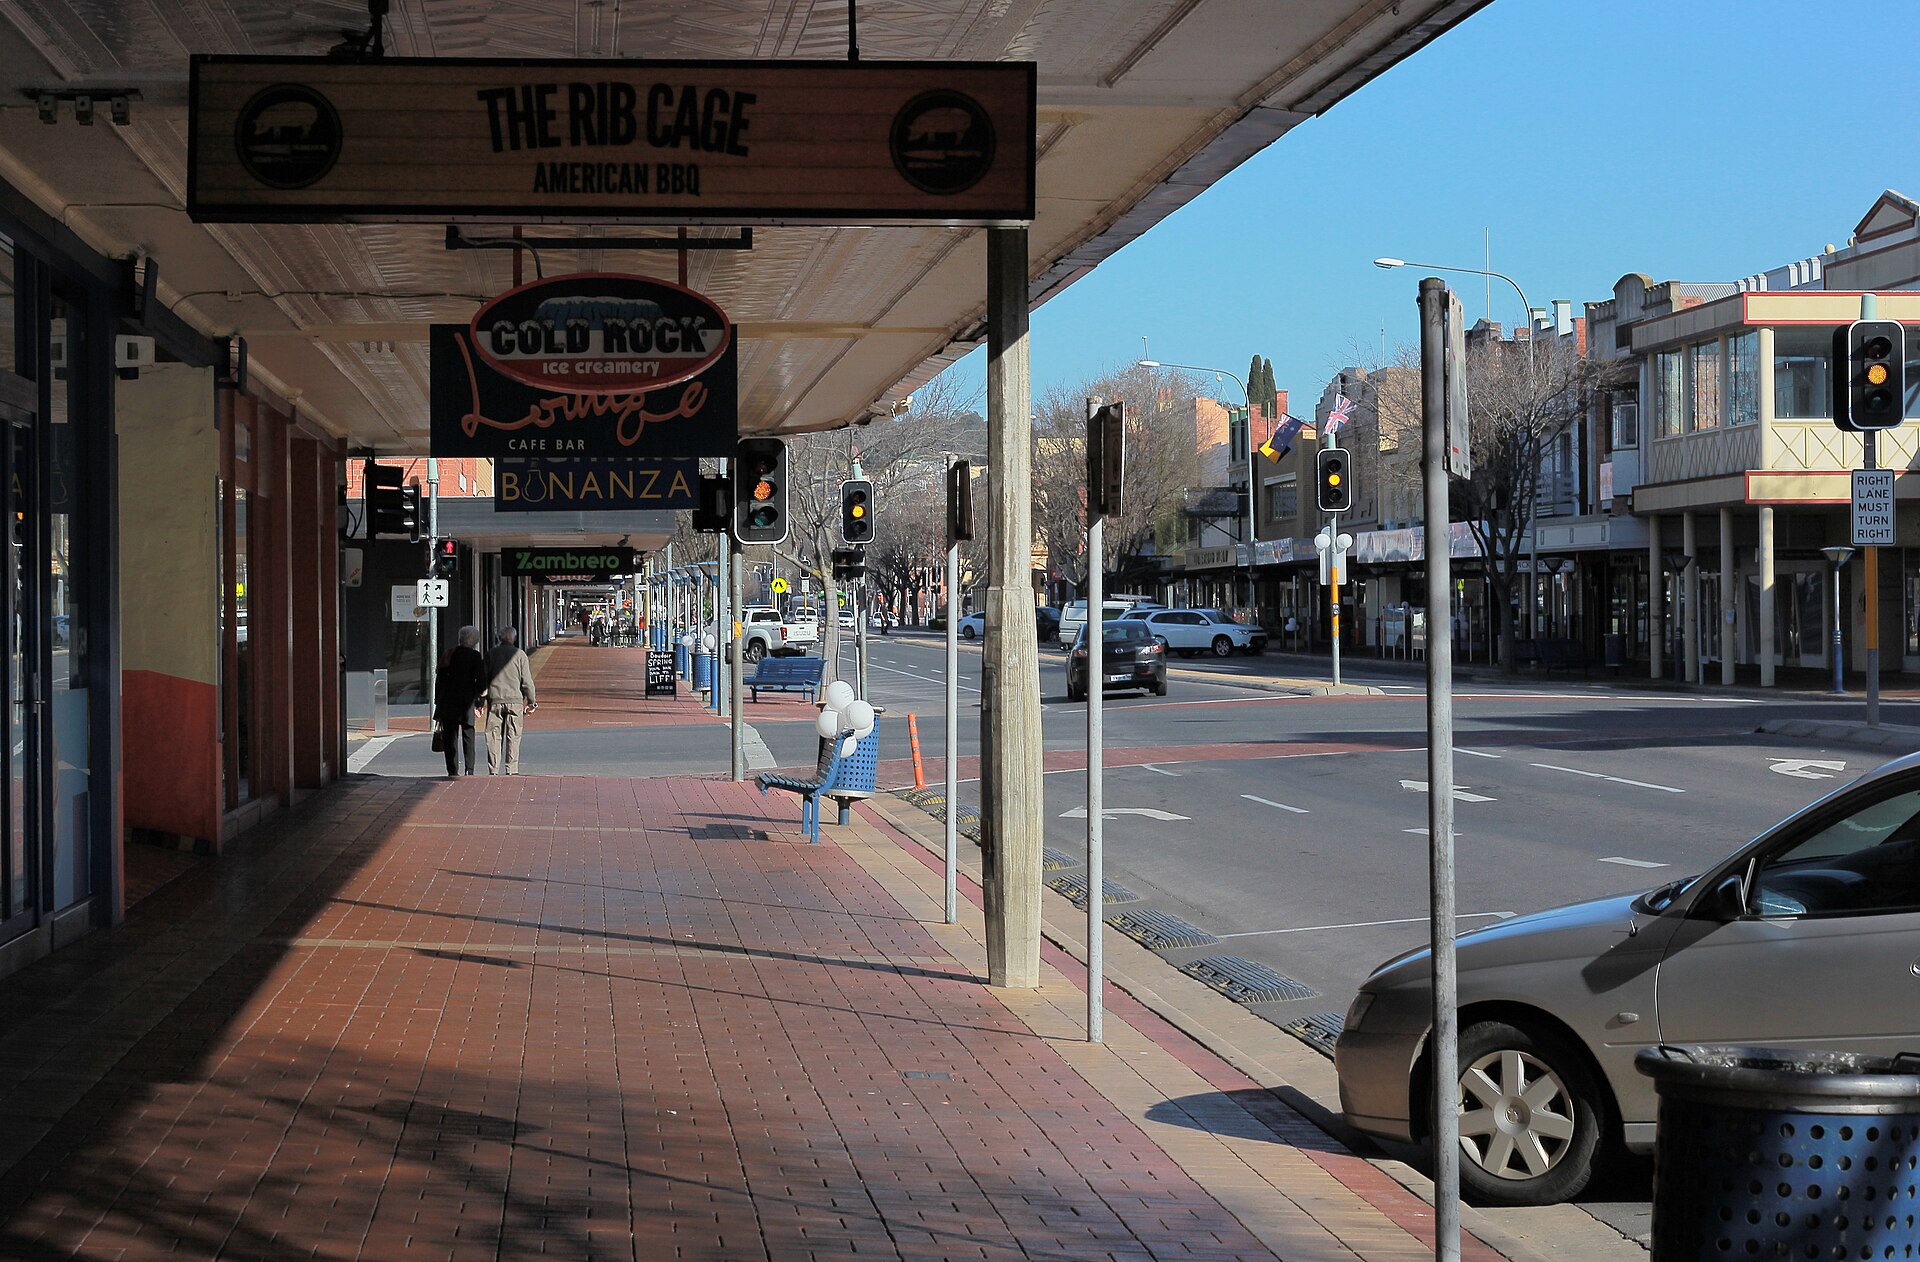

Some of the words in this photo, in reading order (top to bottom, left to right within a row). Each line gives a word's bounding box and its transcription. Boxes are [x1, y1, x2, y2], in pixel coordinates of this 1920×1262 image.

[477, 83, 561, 153] THE
[568, 81, 637, 146] RIB
[647, 83, 757, 157] CAGE
[533, 162, 649, 193] AMERICAN
[656, 163, 700, 196] BBQ
[490, 318, 590, 355] COLD
[603, 315, 706, 353] ROCK
[543, 361, 571, 374] ice
[575, 360, 660, 377] creamery
[508, 439, 547, 450] CAFE
[556, 438, 586, 450] BAR
[1857, 476, 1890, 486] RIGHT
[1858, 489, 1889, 498] LANE
[1858, 503, 1889, 512] MUST
[1858, 516, 1888, 525] TURN
[1857, 529, 1890, 538] RIGHT
[515, 552, 620, 570] Zambrero
